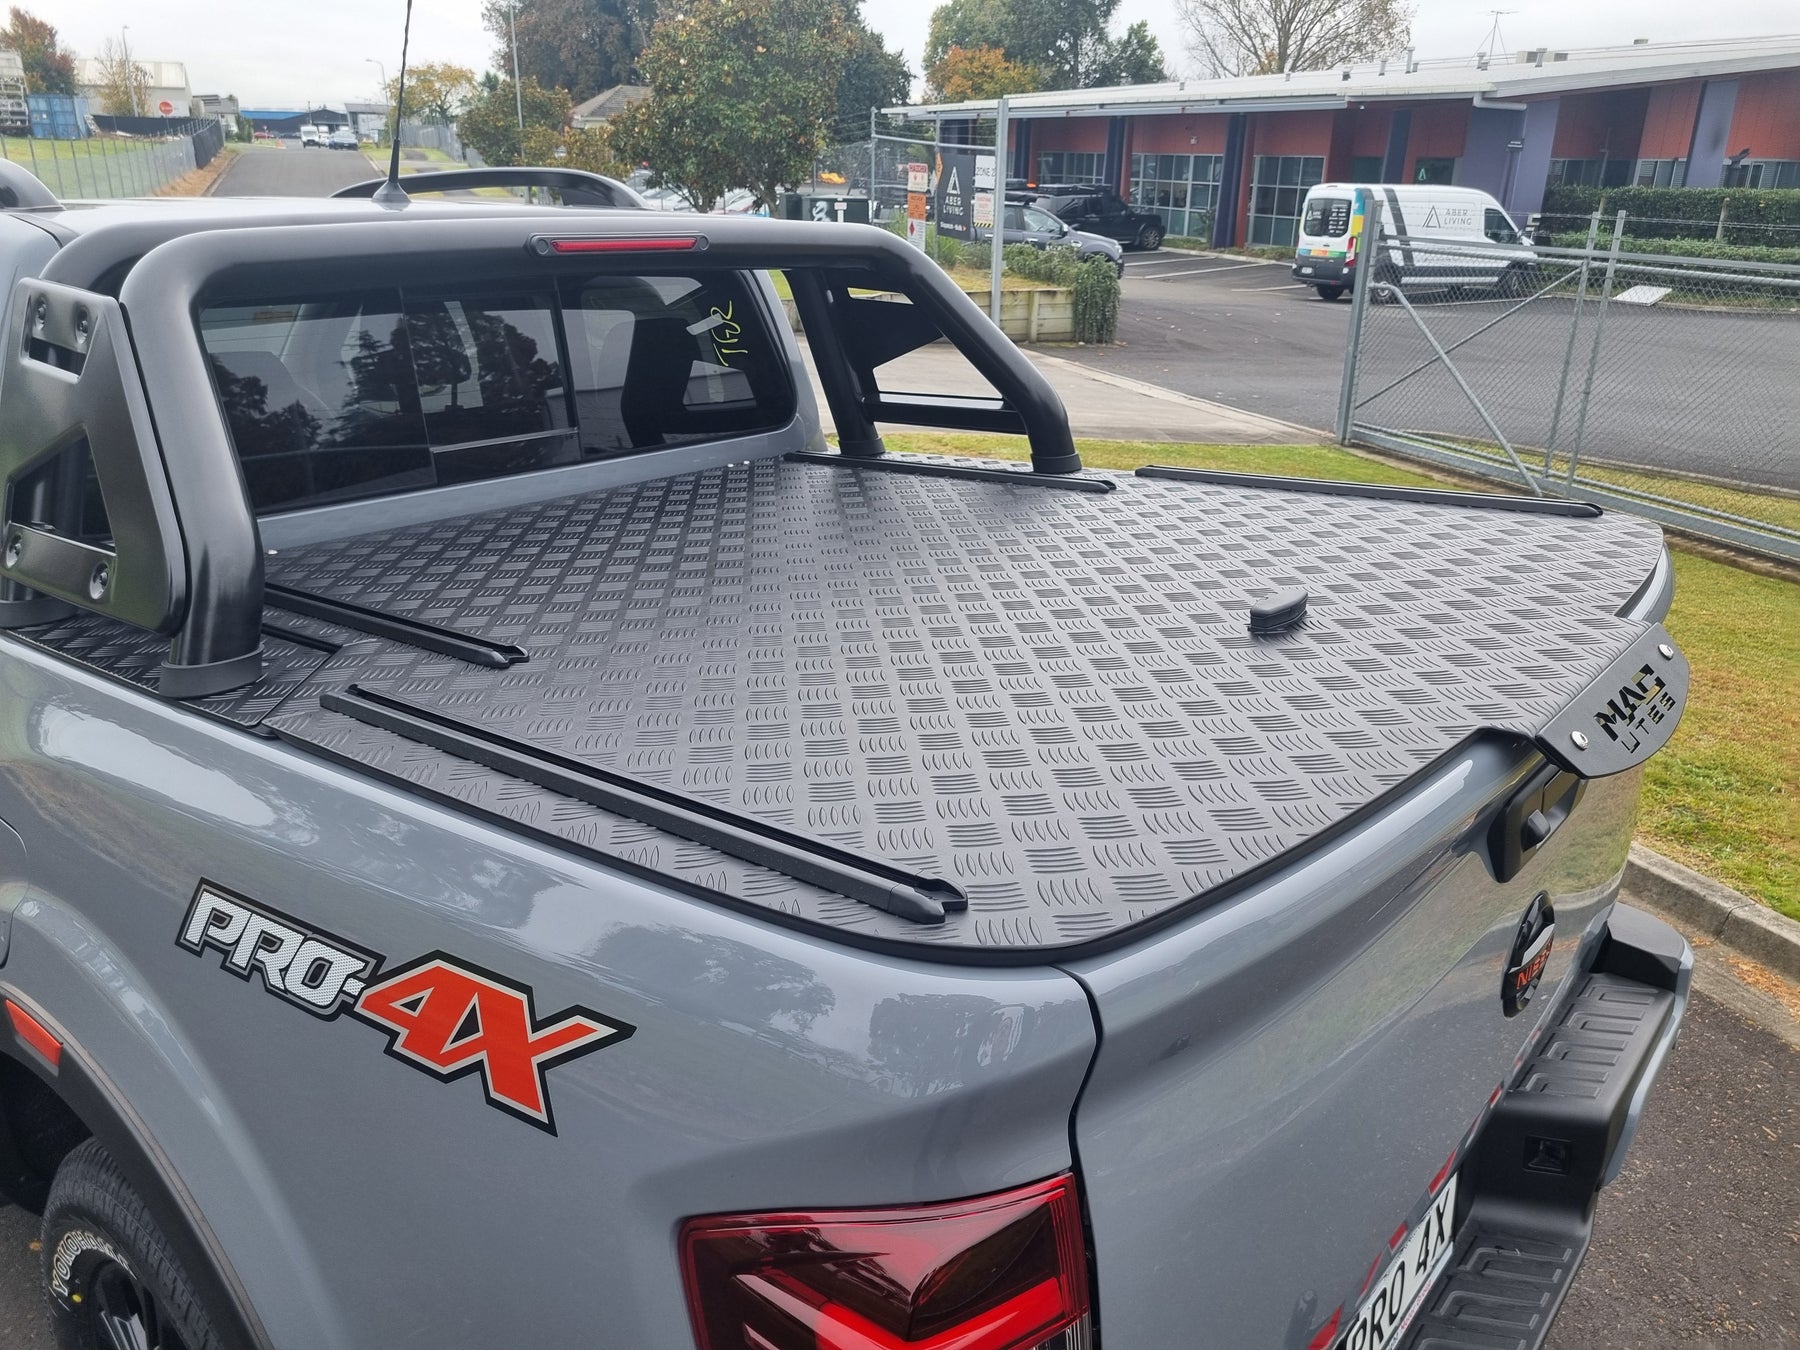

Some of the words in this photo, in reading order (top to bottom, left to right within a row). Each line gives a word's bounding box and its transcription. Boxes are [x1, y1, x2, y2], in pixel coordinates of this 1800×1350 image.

[944, 196, 962, 206] ABER
[943, 204, 964, 216] LIVING
[1445, 208, 1468, 216] ABER
[1444, 217, 1472, 225] LIVING
[1621, 691, 1676, 754] UTES
[1352, 1260, 1405, 1350] PRO
[1415, 1187, 1450, 1277] 4X
